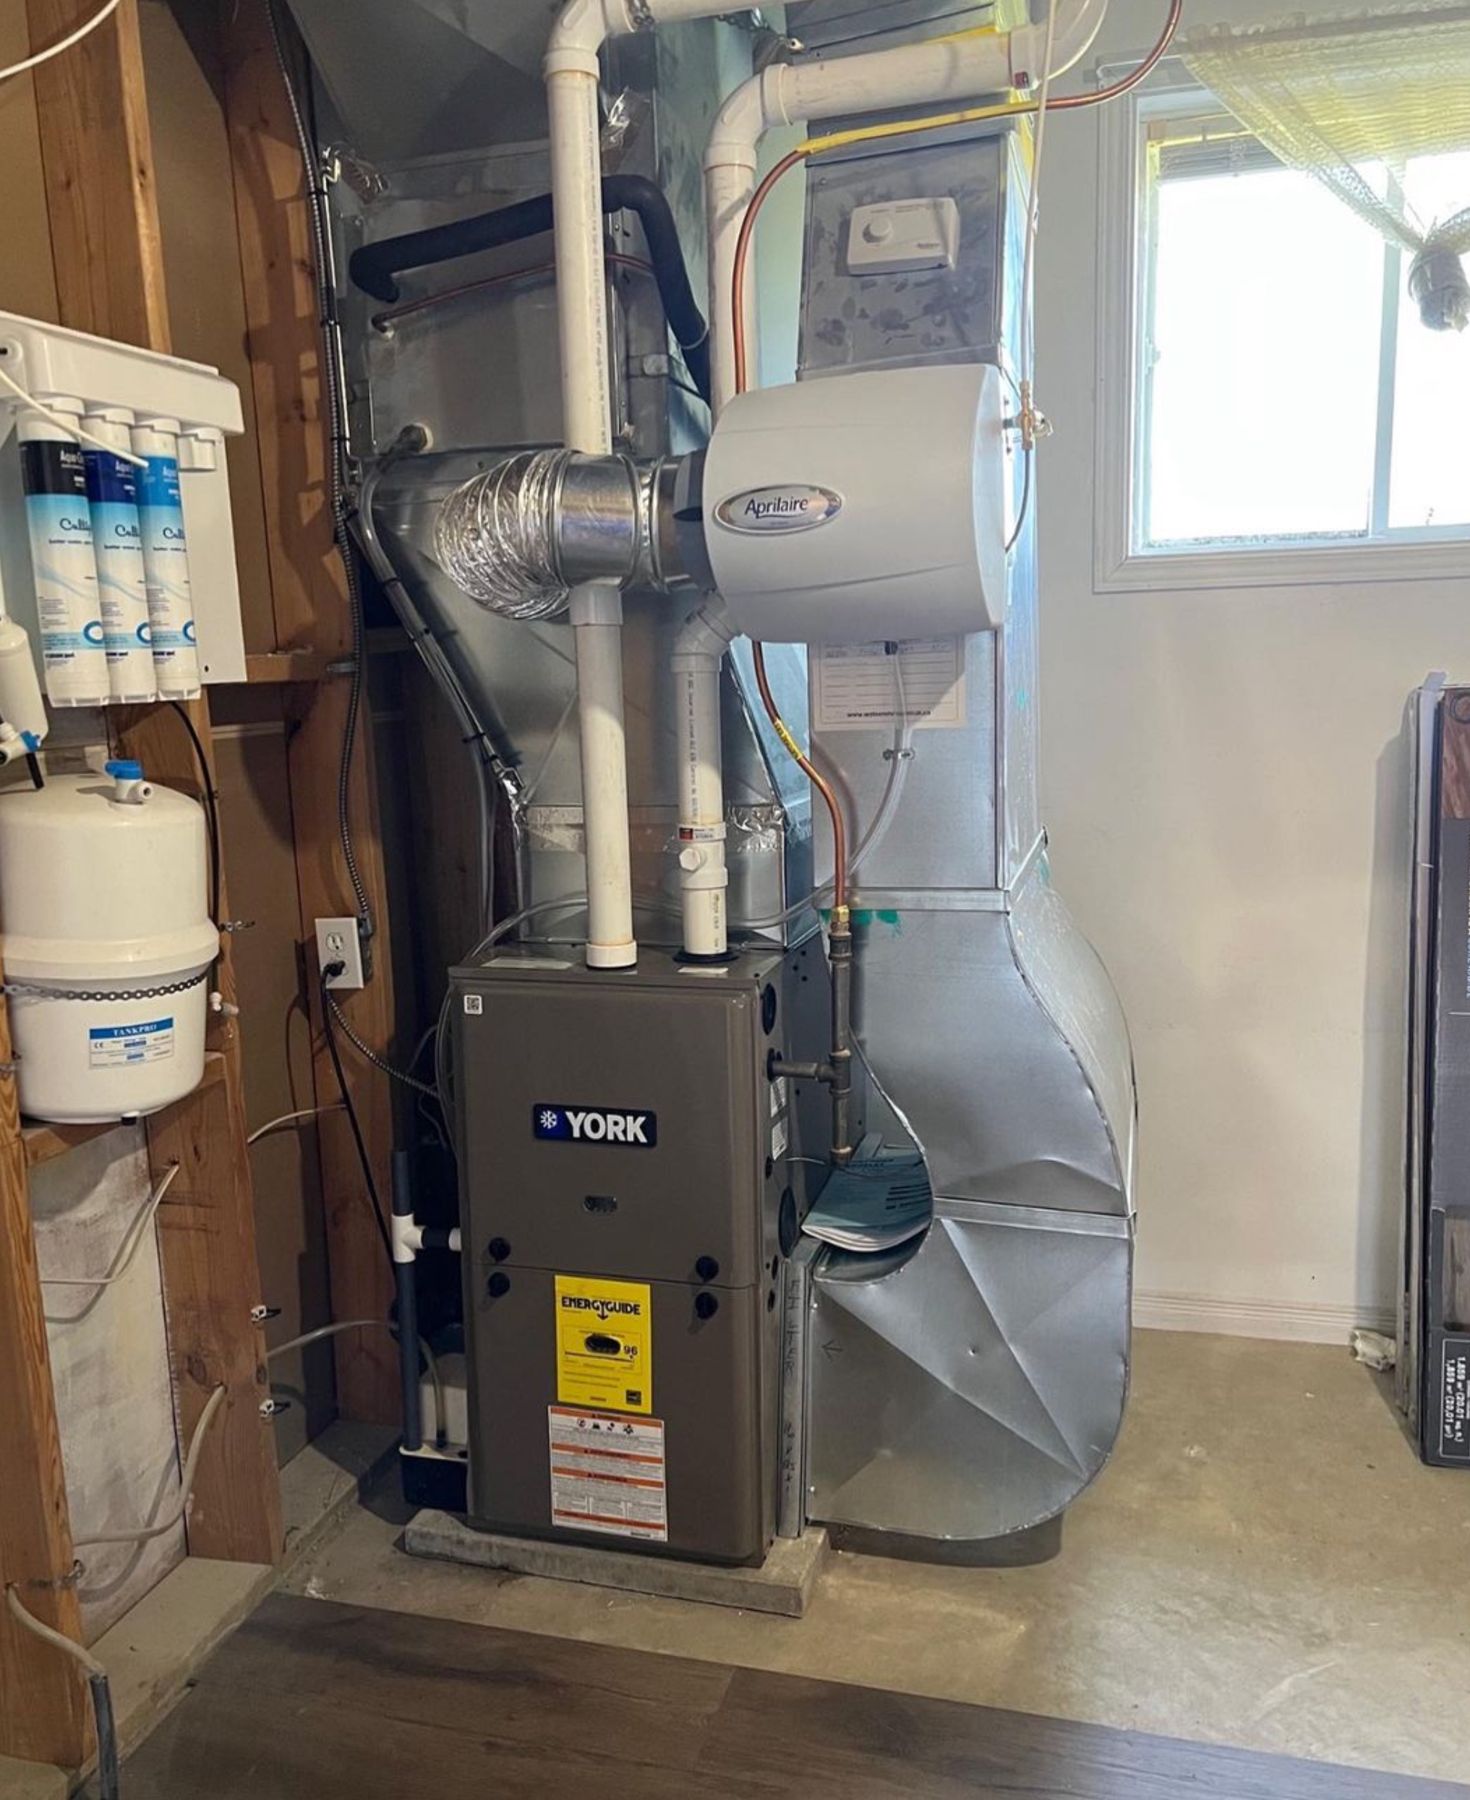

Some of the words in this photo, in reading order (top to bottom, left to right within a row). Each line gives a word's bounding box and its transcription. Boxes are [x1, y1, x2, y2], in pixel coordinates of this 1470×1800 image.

[744, 496, 809, 519] Aprilaire
[565, 1111, 648, 1143] YORK
[623, 1345, 638, 1356] 96
